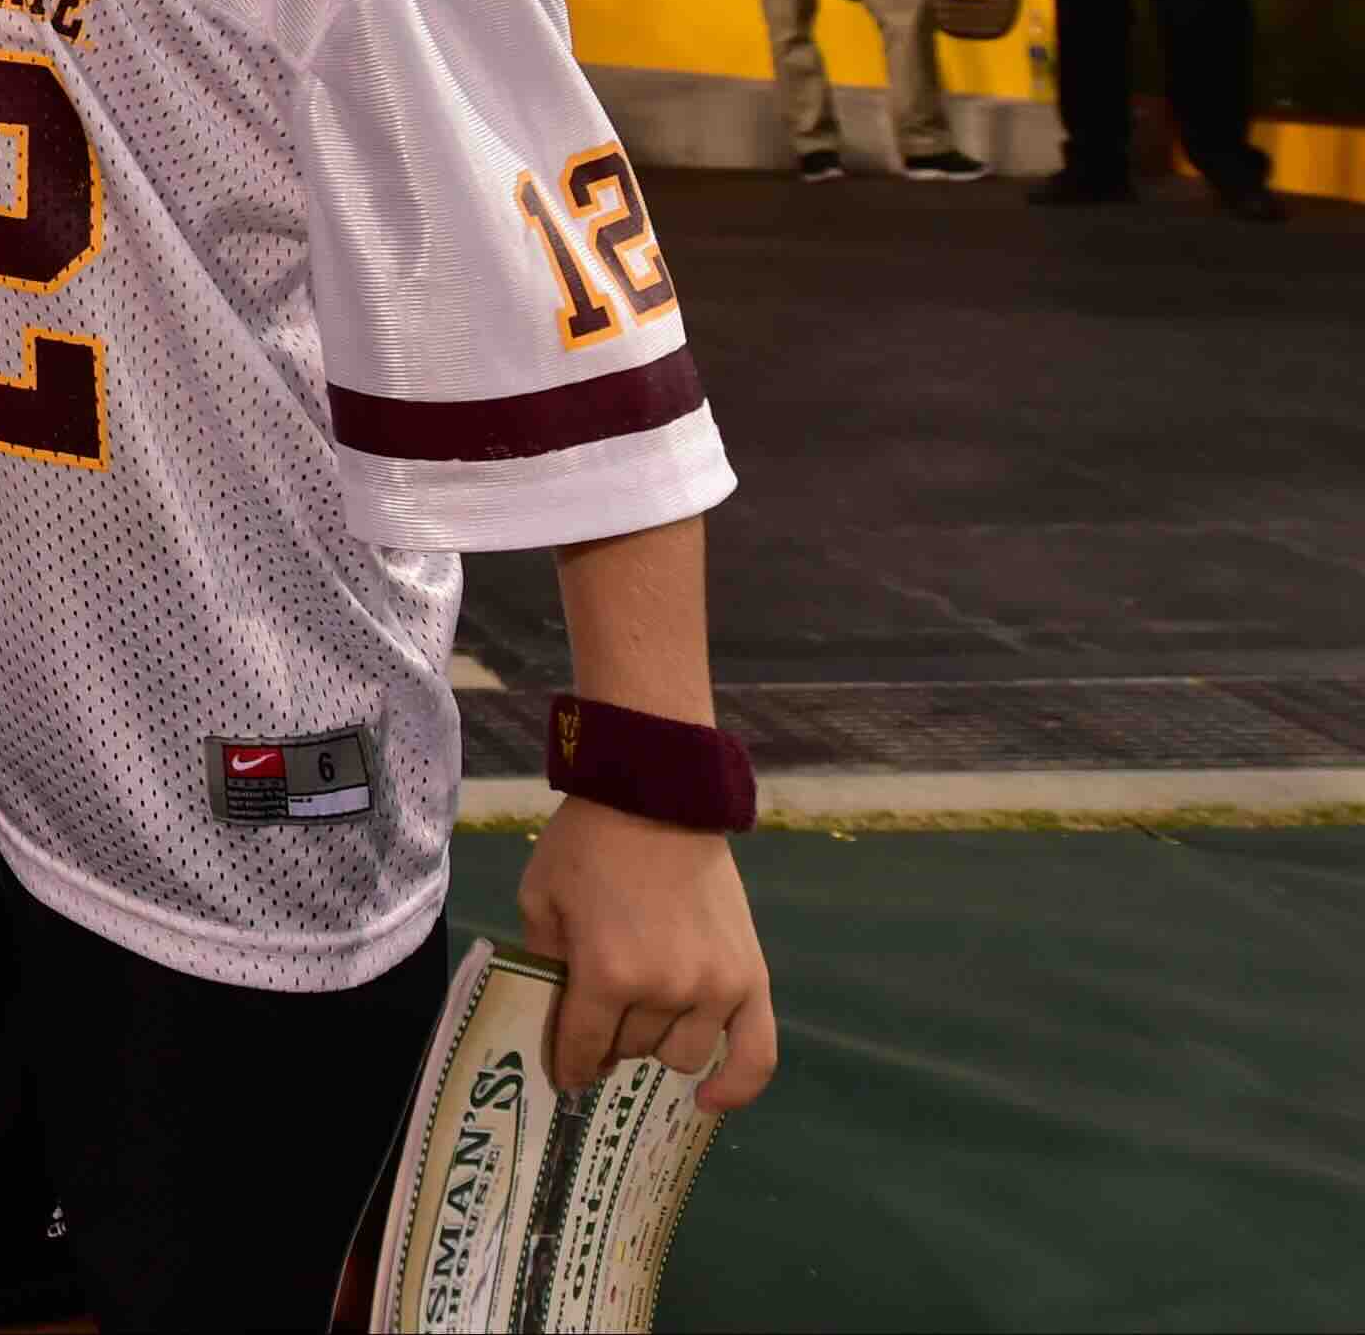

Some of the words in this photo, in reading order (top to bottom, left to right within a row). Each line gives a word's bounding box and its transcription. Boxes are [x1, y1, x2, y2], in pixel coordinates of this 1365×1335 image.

[514, 140, 678, 353] 12
[318, 752, 336, 783] 6
[572, 1061, 651, 1301] outside
